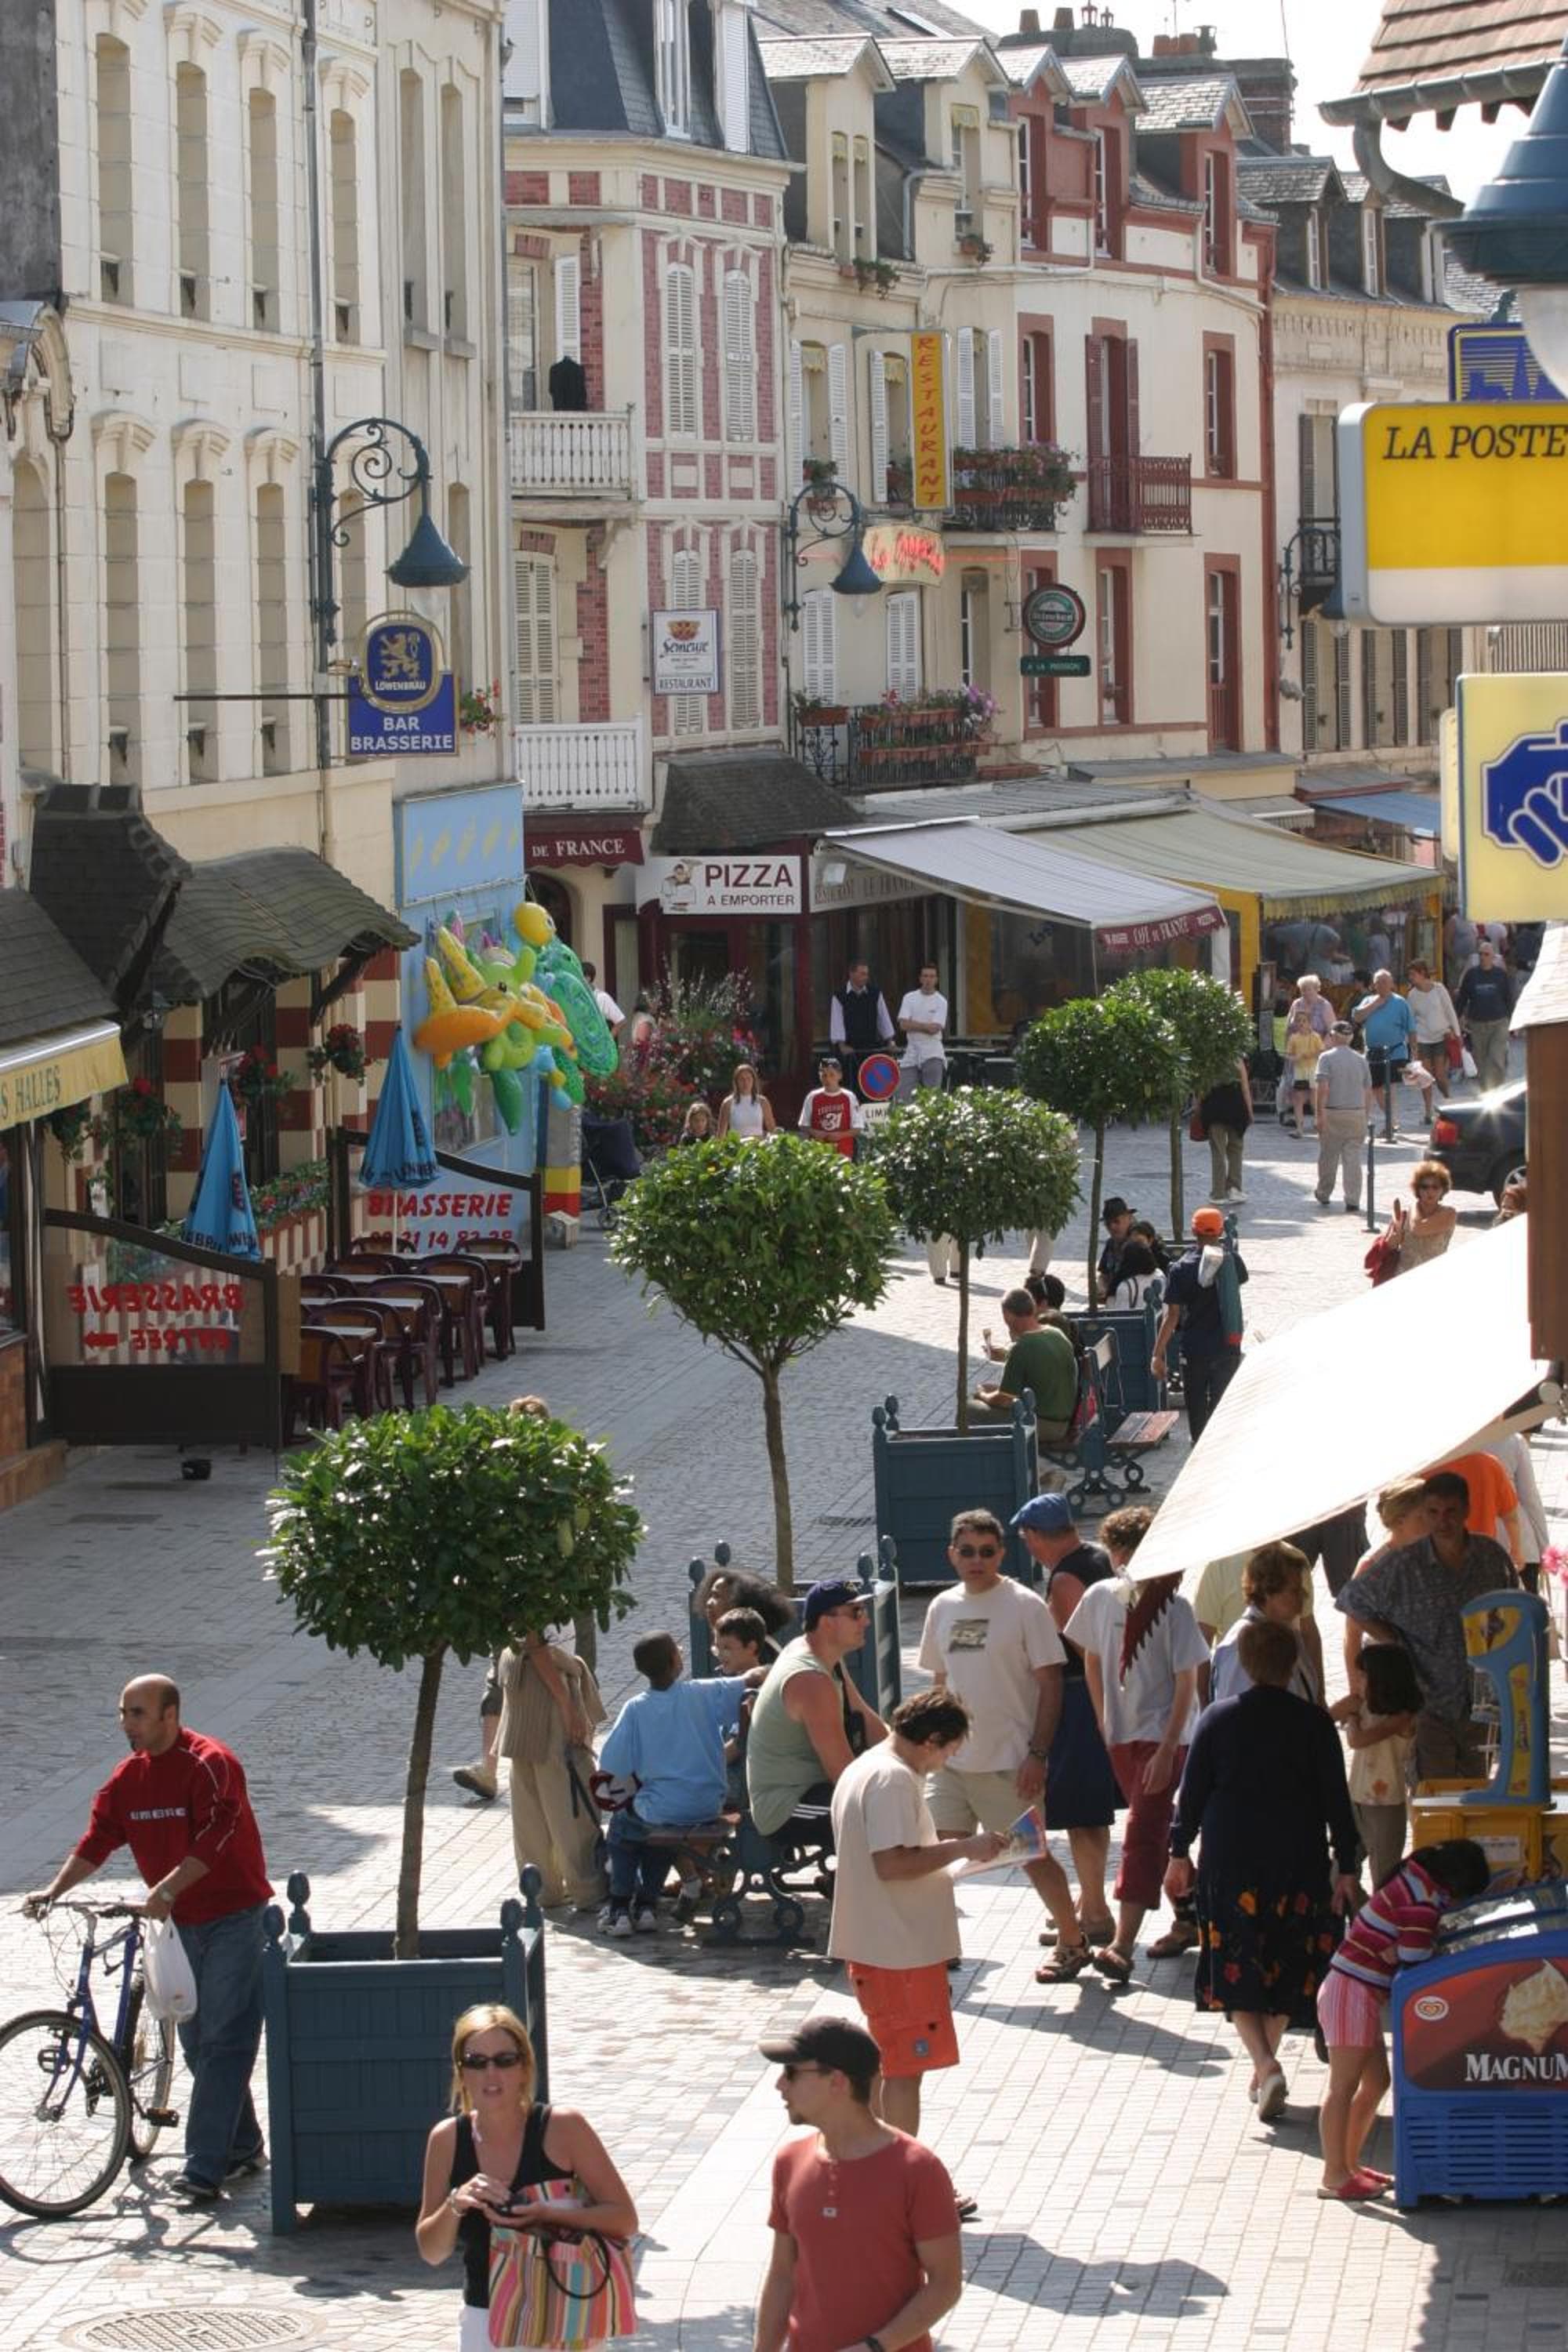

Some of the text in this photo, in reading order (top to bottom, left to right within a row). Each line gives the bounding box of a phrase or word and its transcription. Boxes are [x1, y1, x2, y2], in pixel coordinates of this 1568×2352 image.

[918, 337, 941, 503] RESTAURANT
[1383, 423, 1568, 459] LA POSTE
[659, 677, 712, 689] RESTAURANT
[383, 716, 419, 731] BAR
[350, 735, 452, 750] BRASSERIE
[532, 838, 625, 857] DE FRANCE
[706, 864, 793, 887] PIZZA
[707, 895, 794, 906] A EMPORTER
[15, 1065, 60, 1113] HALLES
[368, 1192, 513, 1217] BRASSERIE
[428, 1231, 448, 1248] 14
